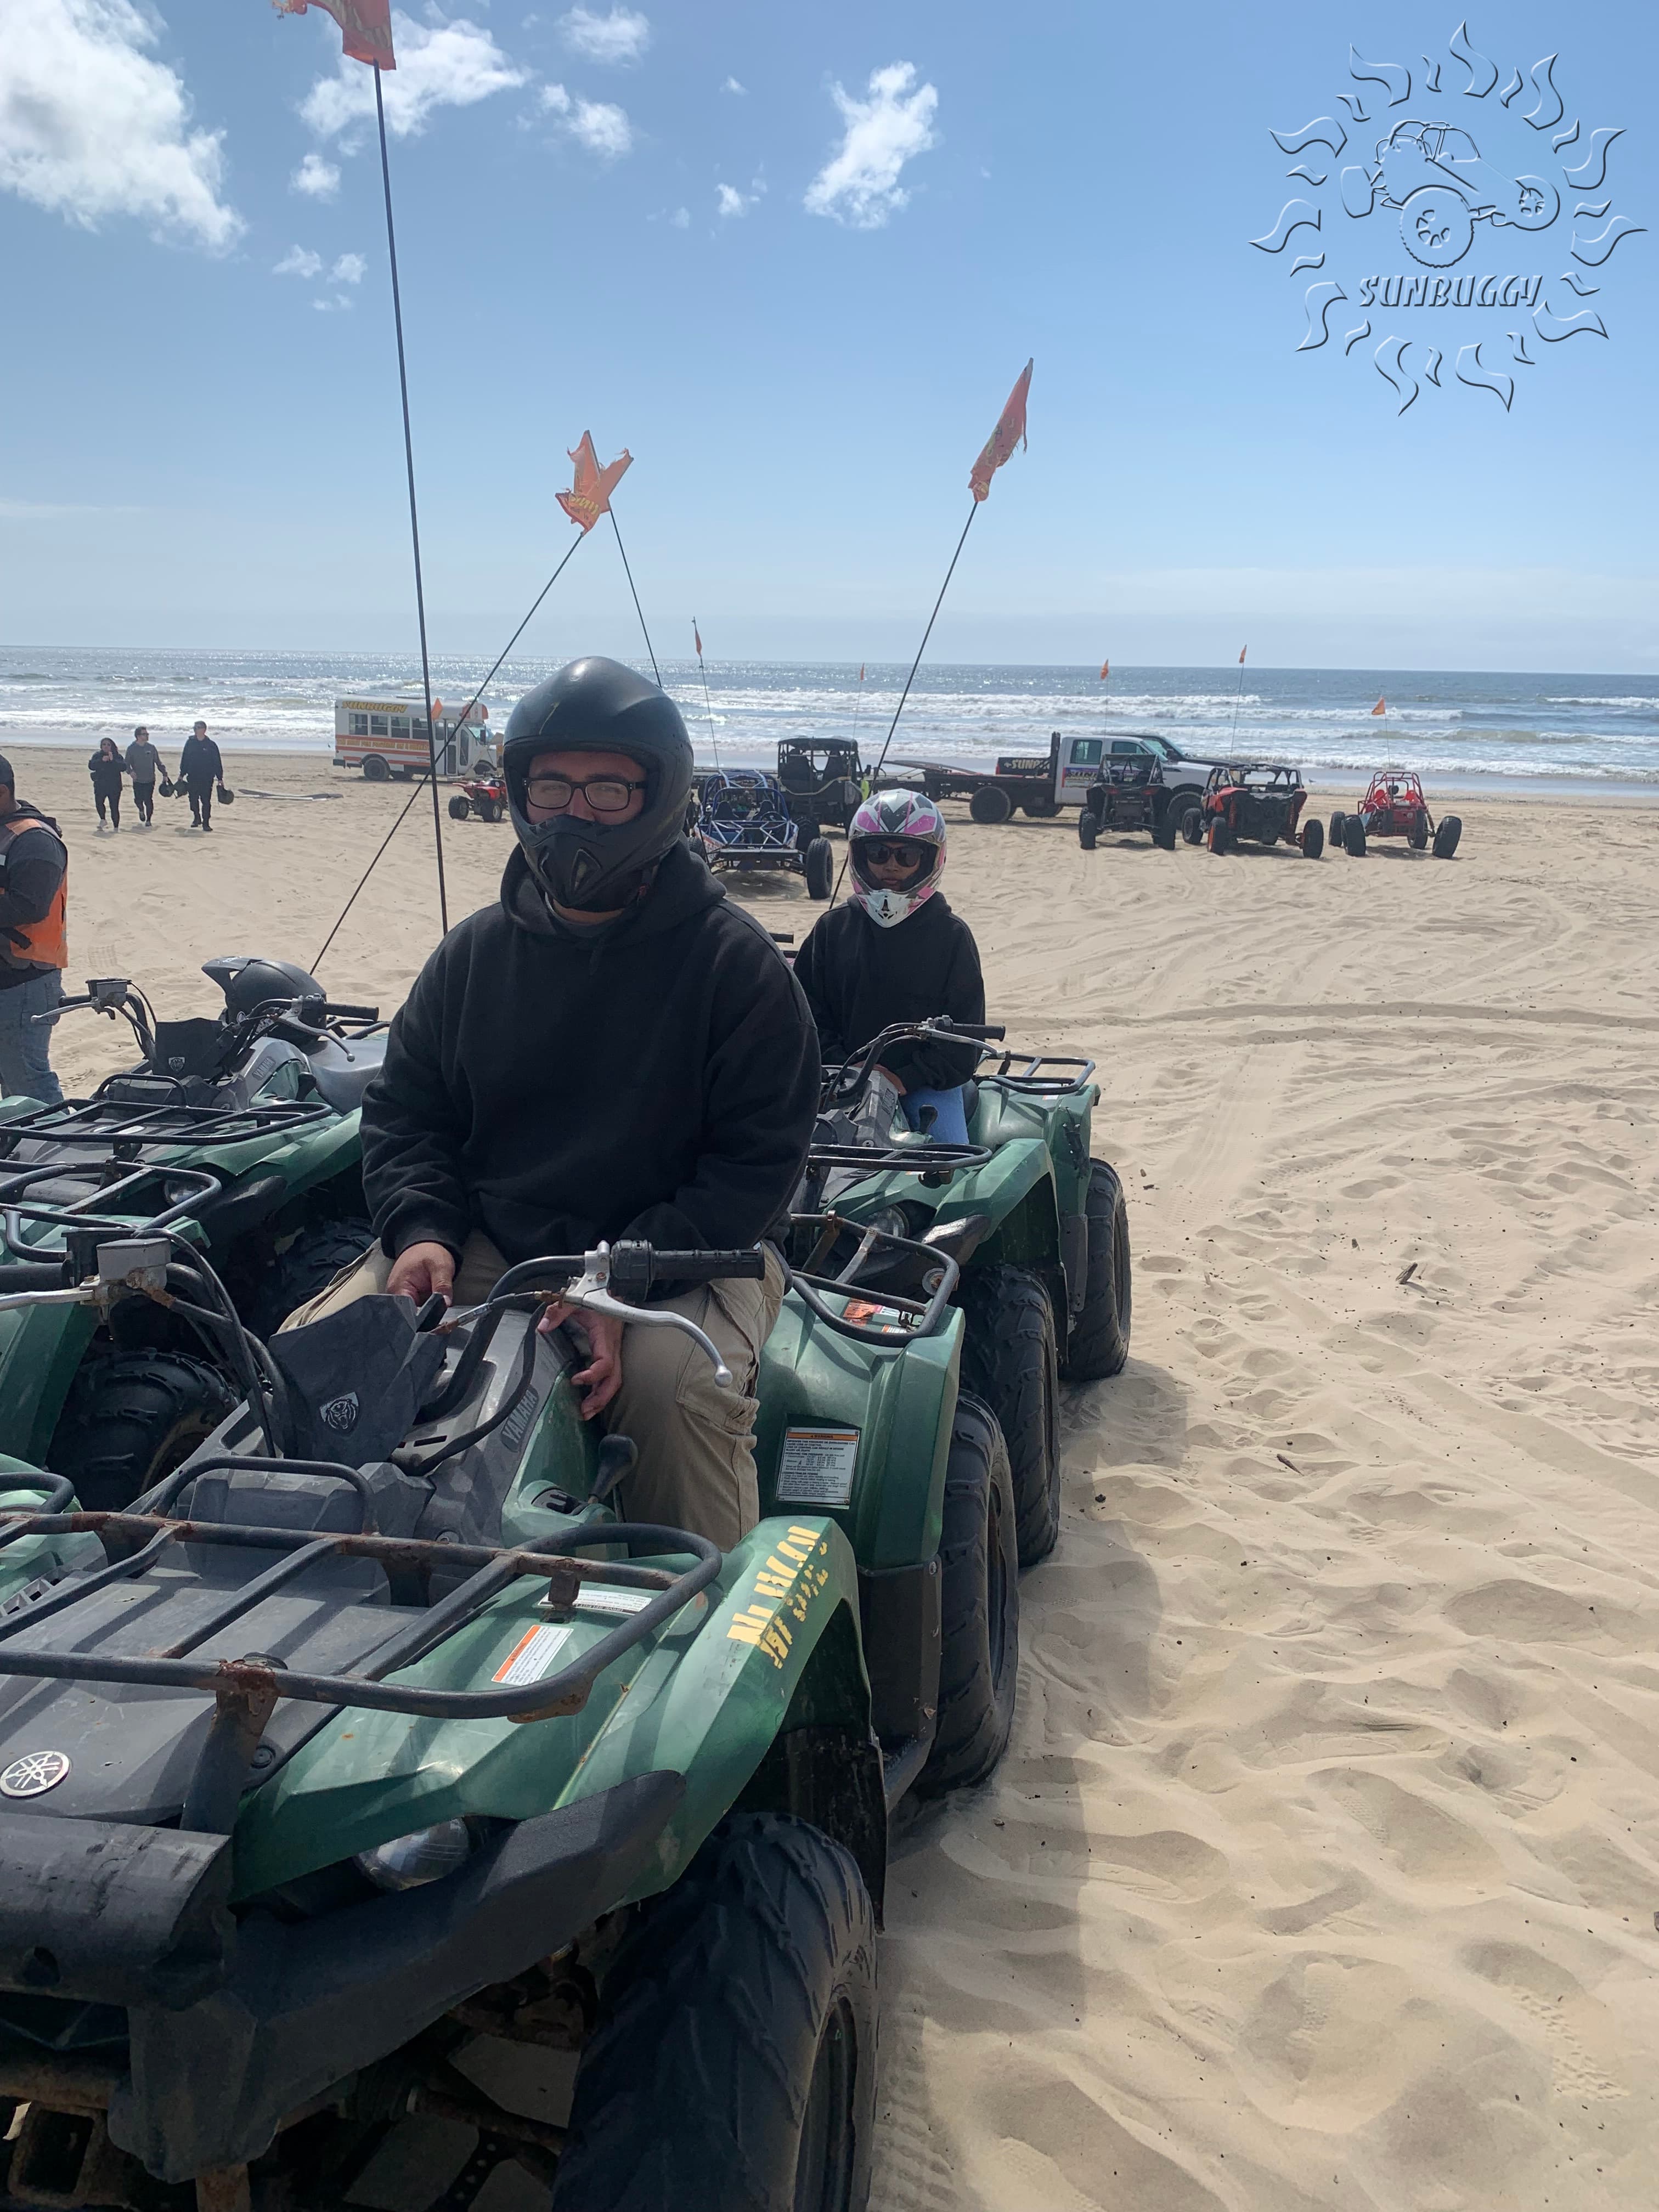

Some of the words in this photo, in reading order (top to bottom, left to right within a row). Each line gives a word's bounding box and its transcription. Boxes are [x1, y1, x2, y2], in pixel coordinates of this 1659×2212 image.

[342, 701, 407, 713] SUNBUGGY
[253, 1058, 275, 1078] YAMAHA
[502, 1390, 537, 1443] YAMAHA
